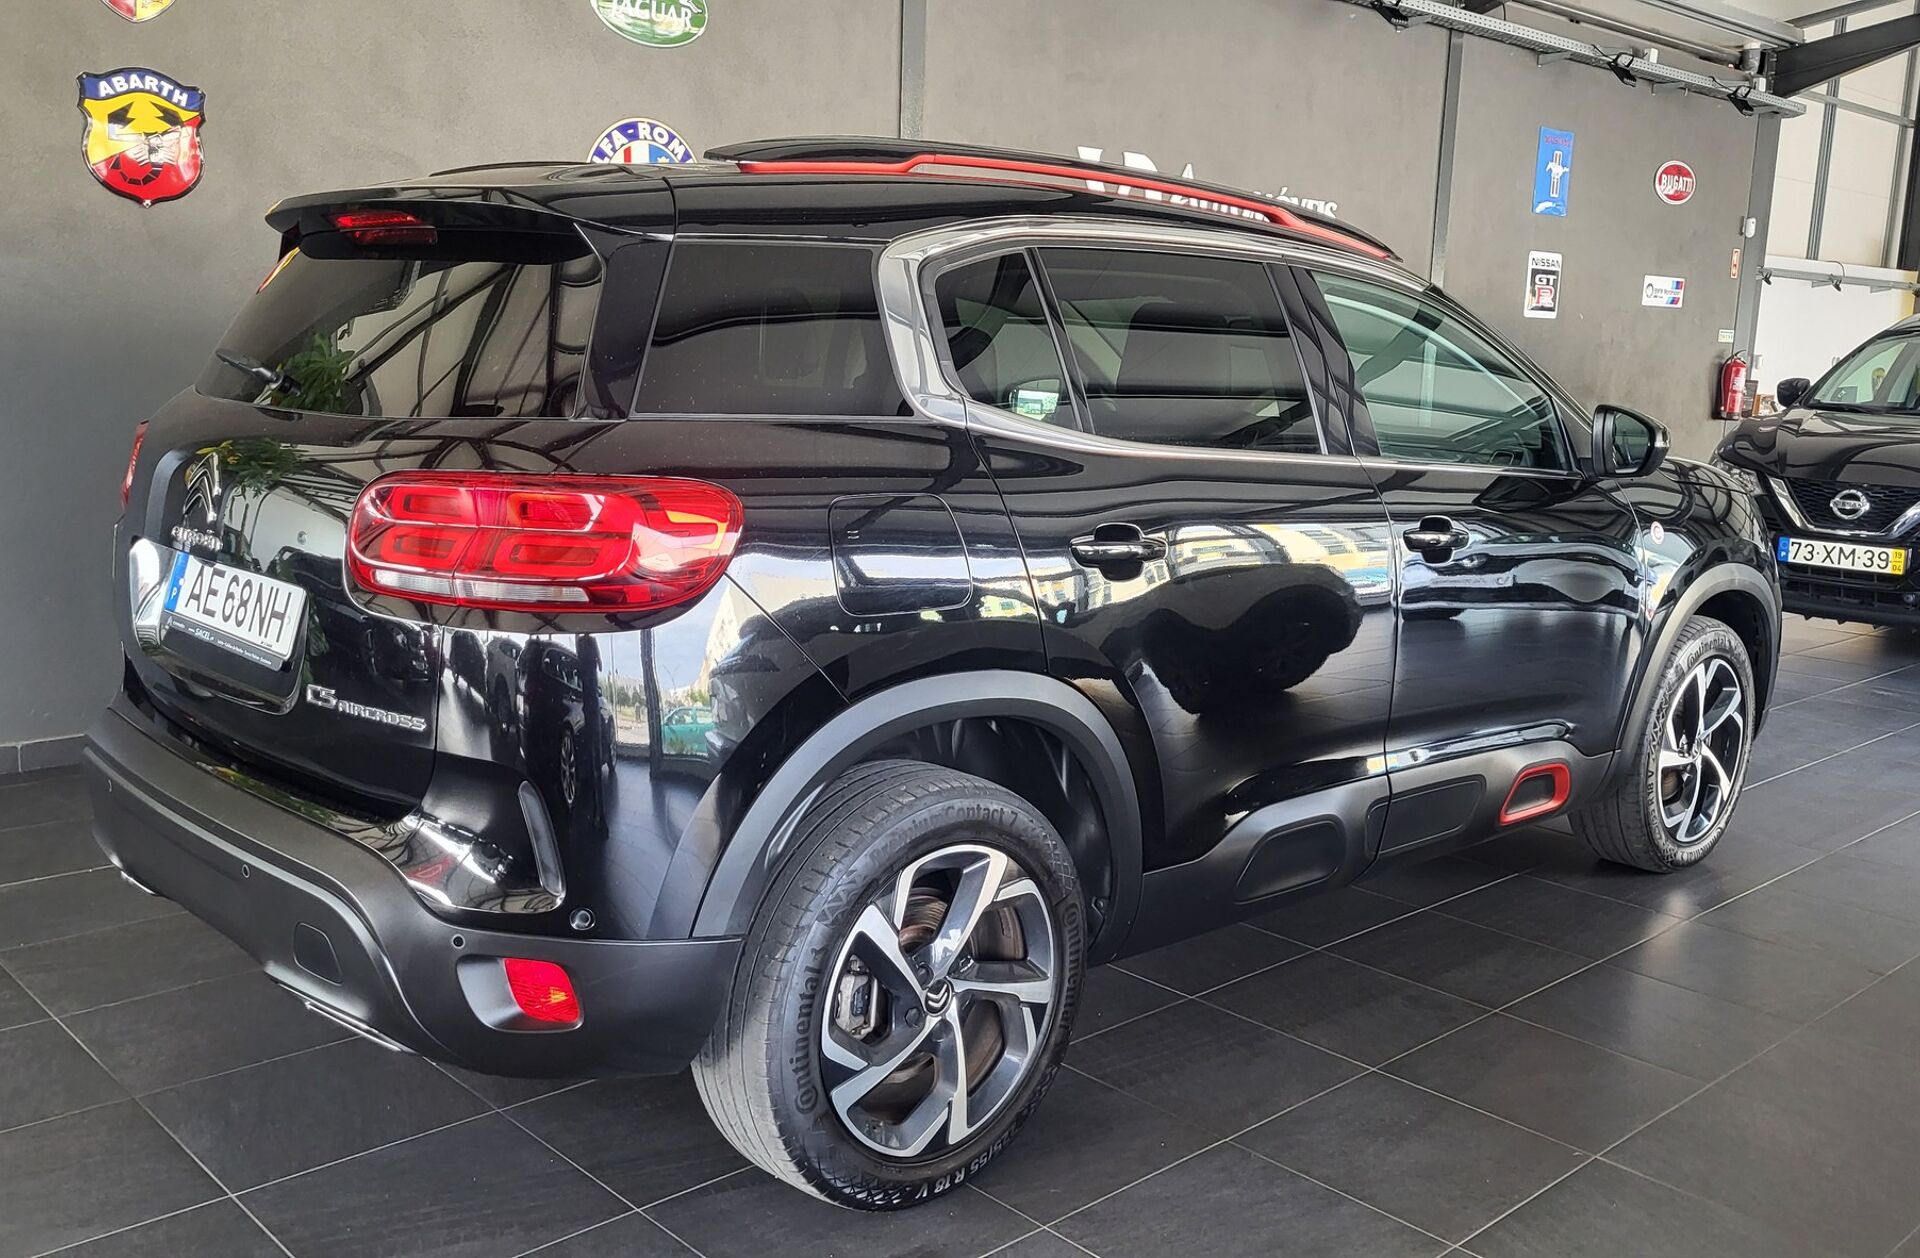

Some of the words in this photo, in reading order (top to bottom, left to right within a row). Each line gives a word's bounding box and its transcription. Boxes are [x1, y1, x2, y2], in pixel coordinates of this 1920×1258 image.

[99, 73, 188, 107] ABARTH
[592, 121, 694, 164] LFA-ROM
[1660, 173, 1692, 192] BUGATTI
[1531, 257, 1560, 268] NISSAN
[1534, 274, 1557, 286] GT
[1894, 551, 1903, 560] 19
[1892, 564, 1902, 572] 04
[171, 587, 178, 599] P
[337, 699, 428, 731] AIRCROSS
[795, 965, 822, 1114] Continental
[934, 1175, 951, 1194] 18
[954, 1167, 966, 1185] R
